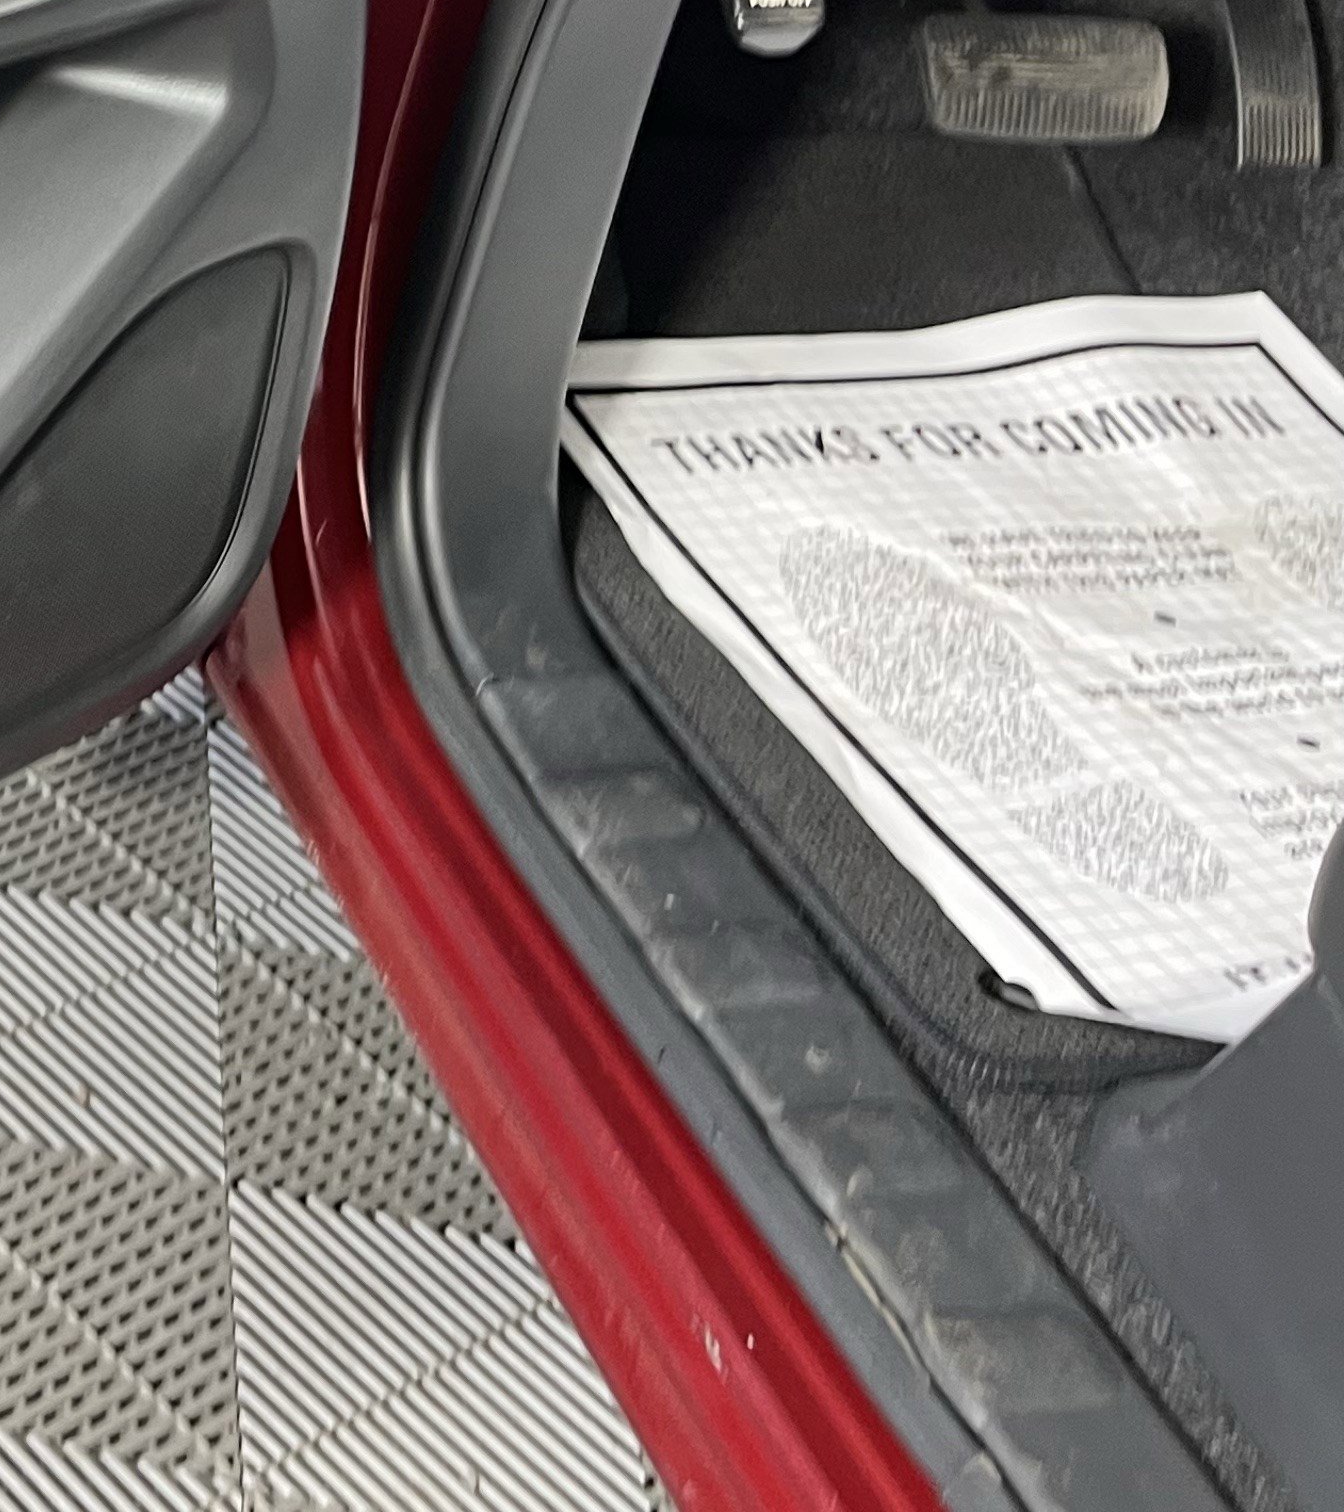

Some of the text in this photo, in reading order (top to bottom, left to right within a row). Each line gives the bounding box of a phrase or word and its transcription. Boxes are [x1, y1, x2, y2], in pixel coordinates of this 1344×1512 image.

[652, 394, 1286, 475] THANKS FOR COMING IN
